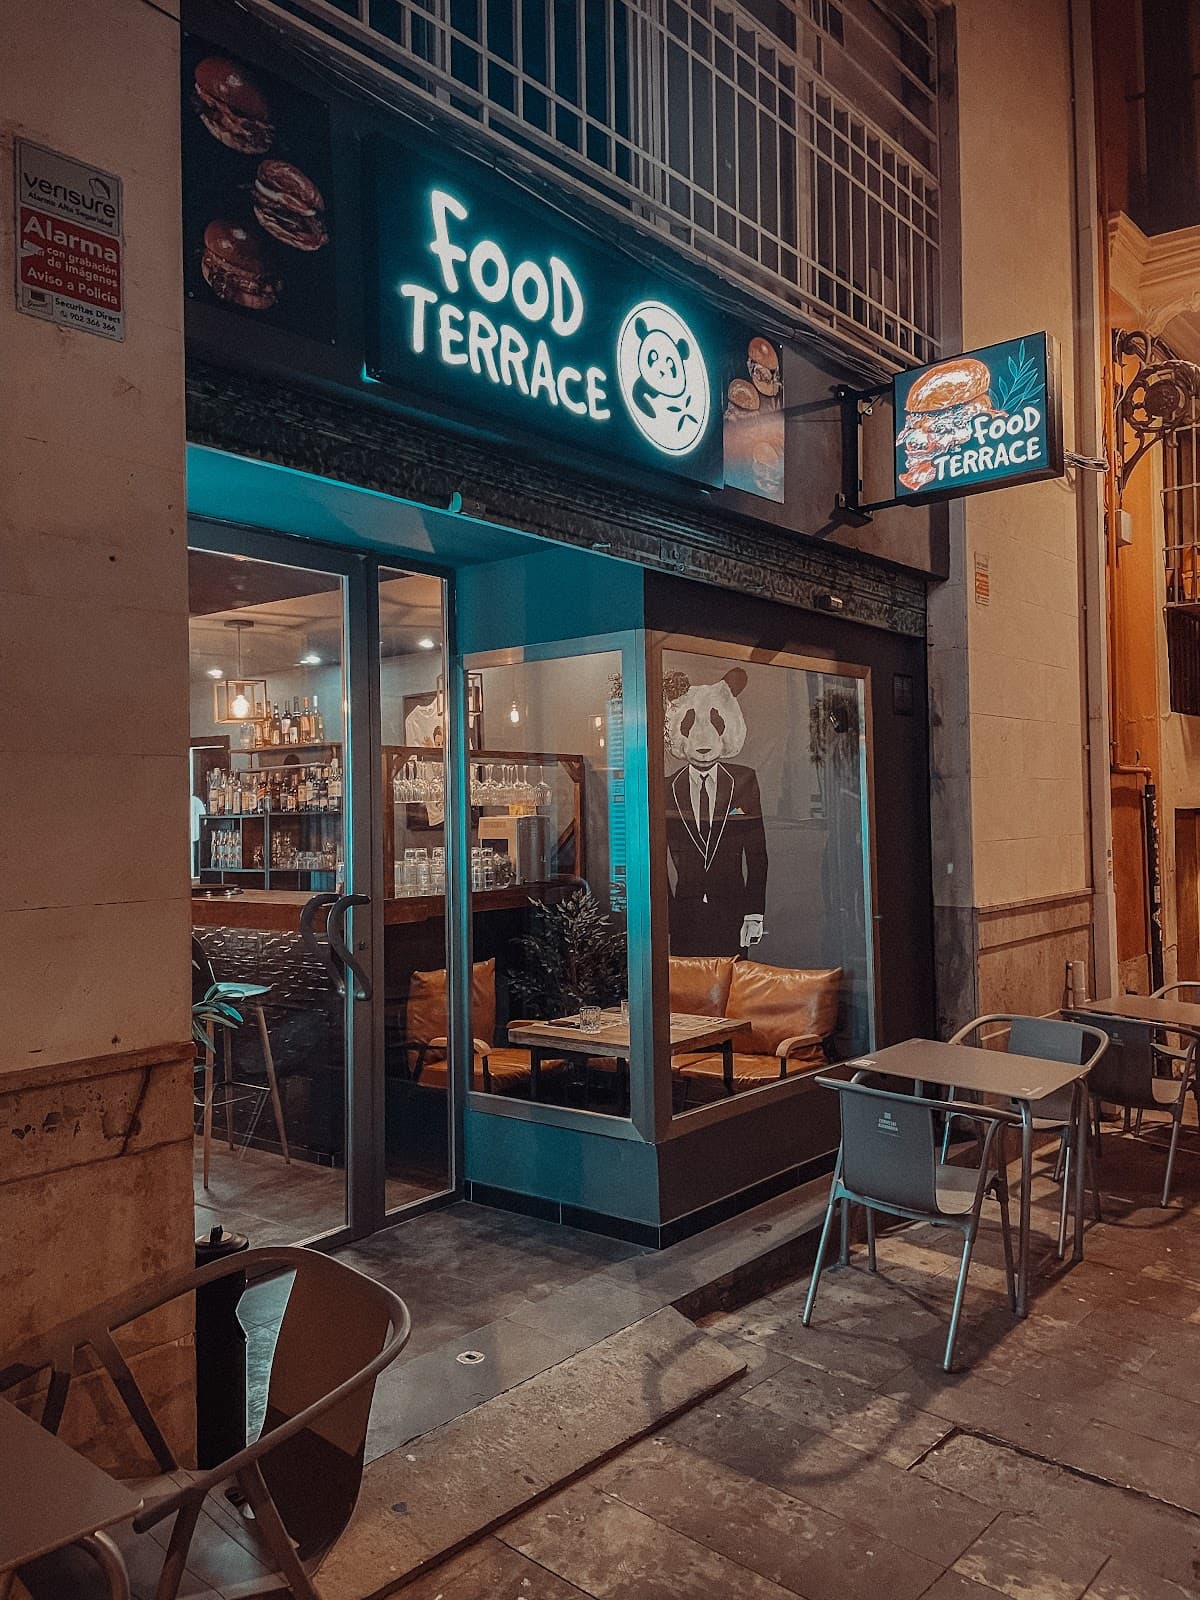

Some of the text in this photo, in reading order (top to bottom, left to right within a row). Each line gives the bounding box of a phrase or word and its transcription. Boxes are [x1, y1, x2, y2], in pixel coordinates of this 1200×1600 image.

[23, 172, 116, 218] verisure
[23, 216, 118, 264] Alarma
[46, 247, 118, 277] con grabación
[47, 256, 118, 288] de imágenes
[27, 266, 63, 287] Aviso
[67, 280, 75, 291] a
[55, 297, 94, 316] Securitas
[95, 309, 121, 324] Direct
[70, 312, 84, 323] 902
[86, 318, 101, 329] 366
[102, 322, 116, 333] 366
[400, 283, 612, 420] TERRACE
[933, 436, 1042, 481] TERRACE
